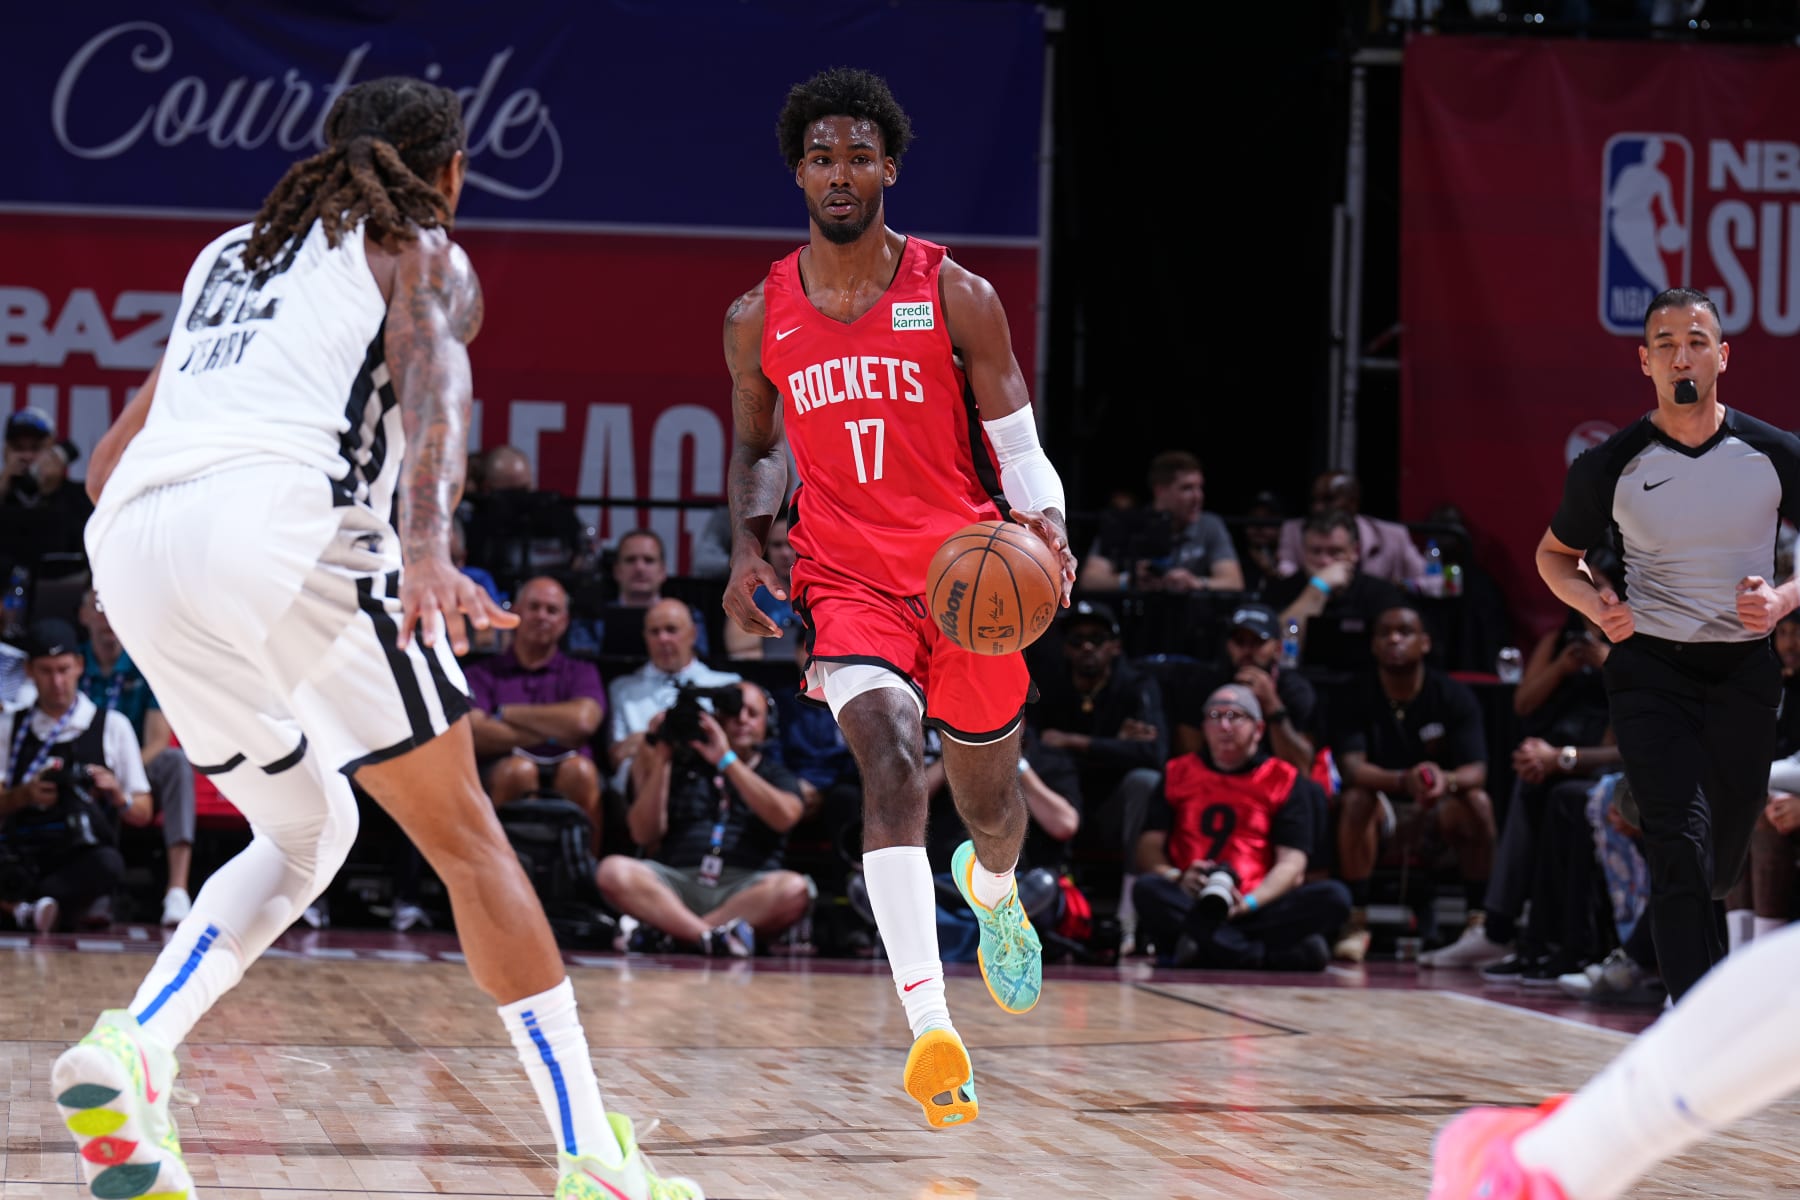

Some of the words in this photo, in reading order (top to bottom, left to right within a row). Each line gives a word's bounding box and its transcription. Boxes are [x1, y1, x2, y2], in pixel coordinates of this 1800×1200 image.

[893, 317, 933, 328] karma
[895, 304, 930, 316] credit
[788, 356, 924, 415] ROCKETS
[845, 418, 884, 484] 17
[1202, 804, 1236, 860] 9
